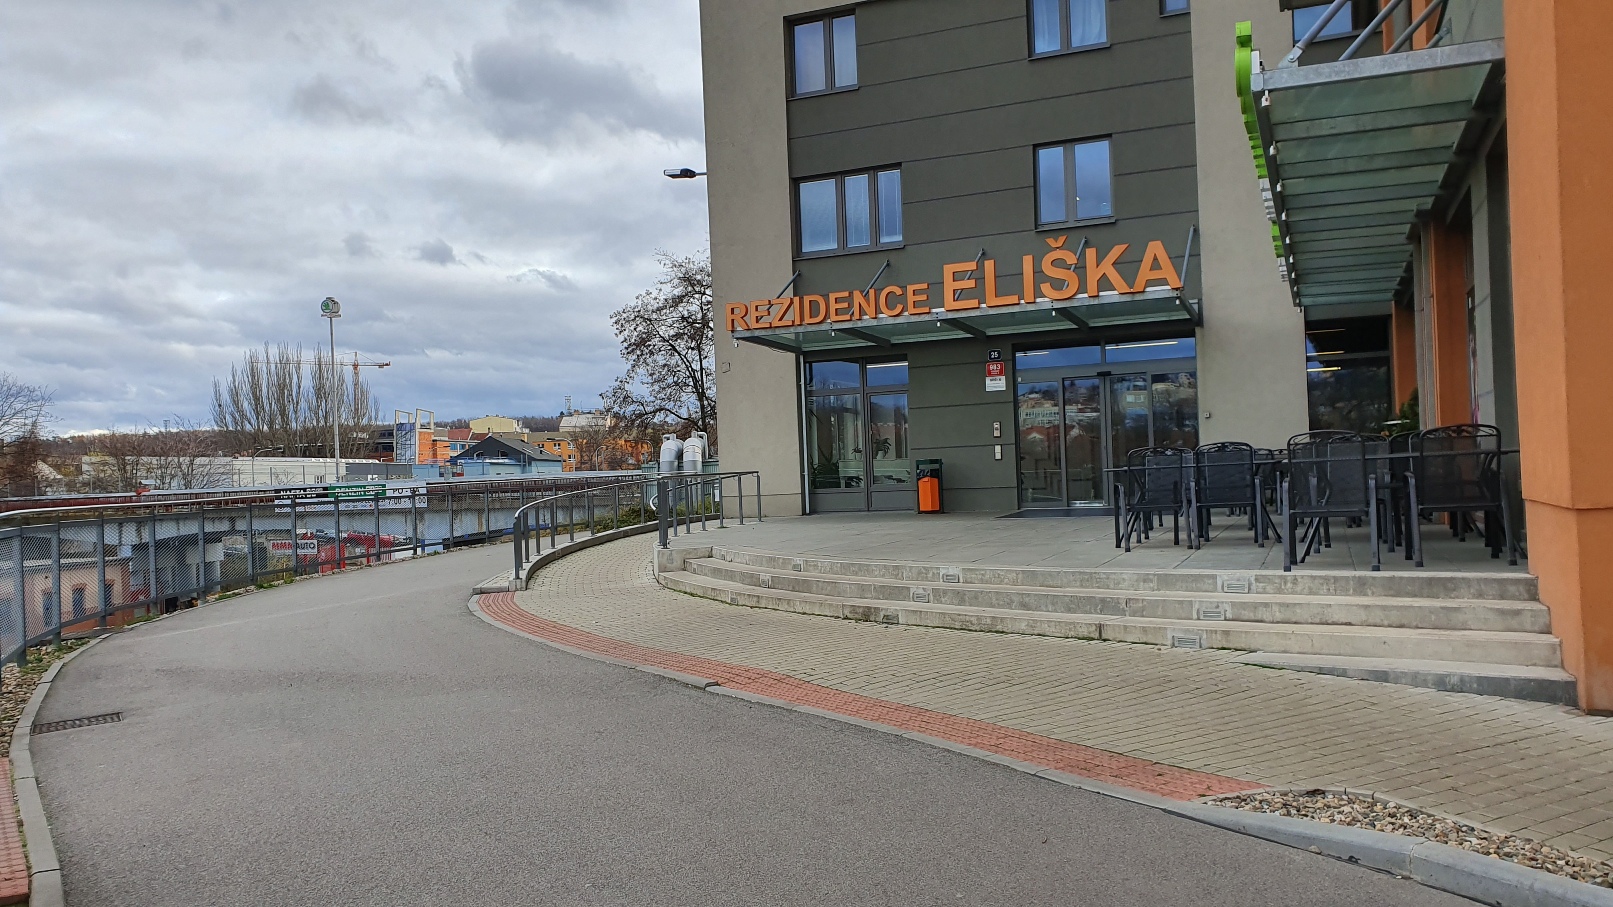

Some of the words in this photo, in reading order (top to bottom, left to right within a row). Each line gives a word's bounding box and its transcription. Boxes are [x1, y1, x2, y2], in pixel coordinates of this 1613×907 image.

[725, 283, 931, 332] REZIDENCE
[943, 234, 1183, 312] ELIŠKA
[335, 486, 364, 496] BENZIN
